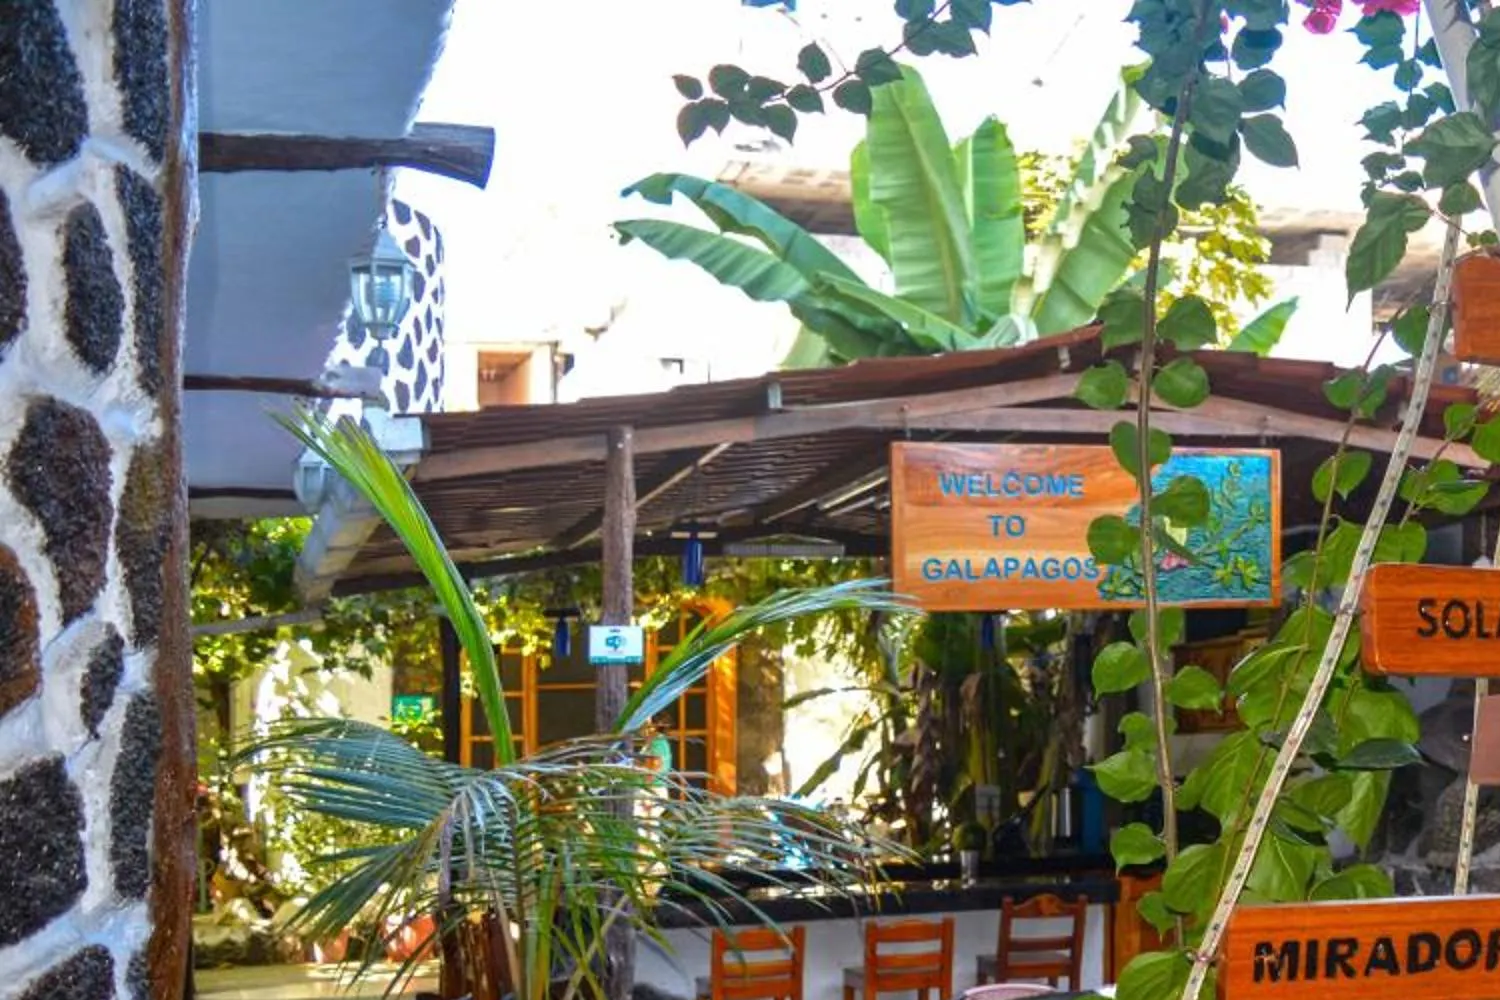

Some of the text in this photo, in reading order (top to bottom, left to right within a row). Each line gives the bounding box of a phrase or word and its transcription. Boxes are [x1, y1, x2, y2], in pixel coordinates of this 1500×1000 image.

[938, 471, 1085, 499] WELCOME
[988, 514, 1025, 539] TO
[921, 557, 1099, 583] GALAPAGOS
